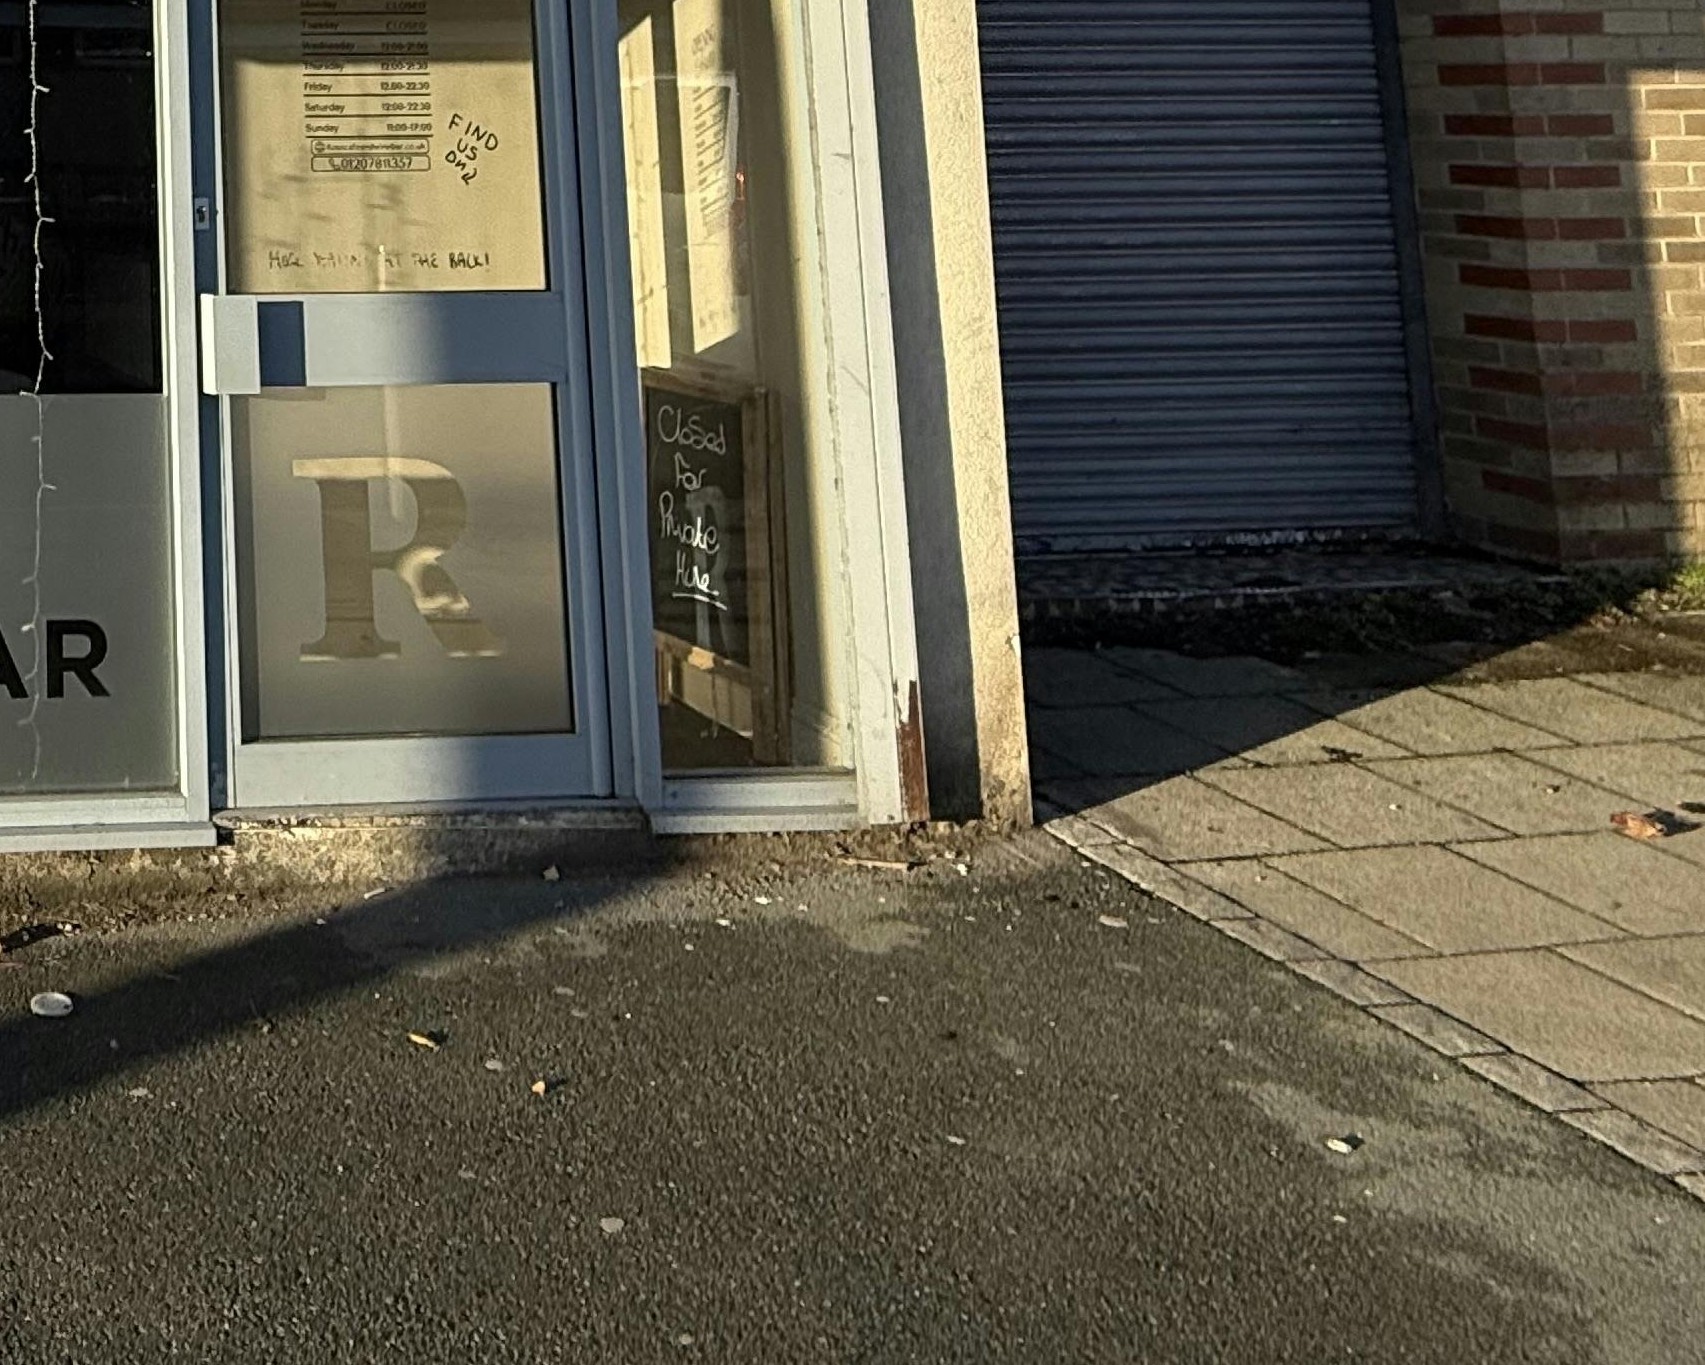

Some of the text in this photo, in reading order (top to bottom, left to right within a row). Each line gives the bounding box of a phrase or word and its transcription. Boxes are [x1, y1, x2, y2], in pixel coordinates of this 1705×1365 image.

[304, 81, 333, 92] Friday
[304, 102, 345, 113] Saturday
[305, 123, 339, 133] Sunday
[448, 112, 499, 151] FIND
[457, 137, 478, 161] US
[410, 252, 440, 270] THE
[448, 251, 490, 270] BACK!
[673, 451, 708, 491] For
[658, 490, 720, 555] Private
[292, 456, 503, 663] R
